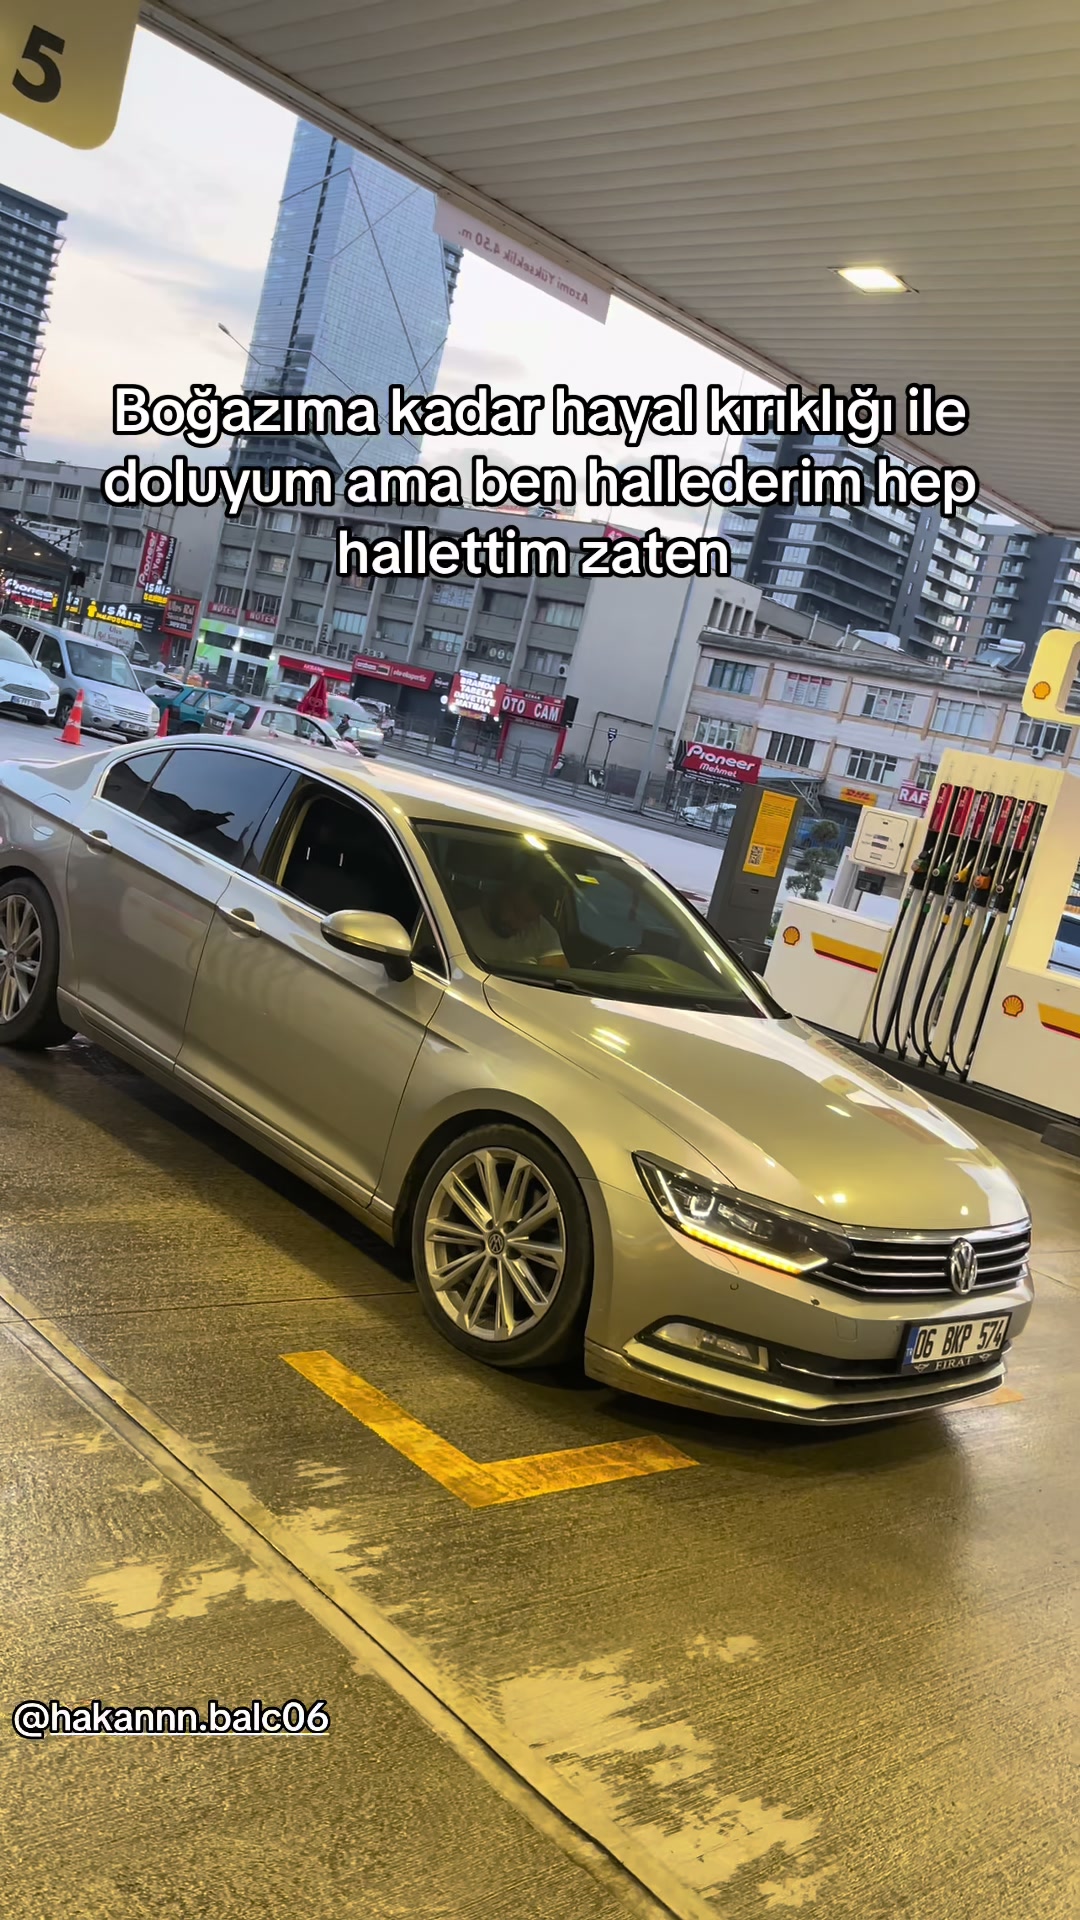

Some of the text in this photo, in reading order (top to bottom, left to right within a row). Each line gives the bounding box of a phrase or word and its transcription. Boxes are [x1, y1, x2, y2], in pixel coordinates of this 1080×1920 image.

[12, 25, 65, 103] 5
[5, 578, 54, 599] Pionee
[502, 696, 560, 722] OTO CAM
[686, 744, 756, 771] Pioneer
[699, 762, 738, 778] Mehmet
[914, 1328, 937, 1360] 06
[941, 1324, 973, 1356] BKP
[976, 1320, 1004, 1350] 574
[934, 1356, 974, 1371] FIRAT
